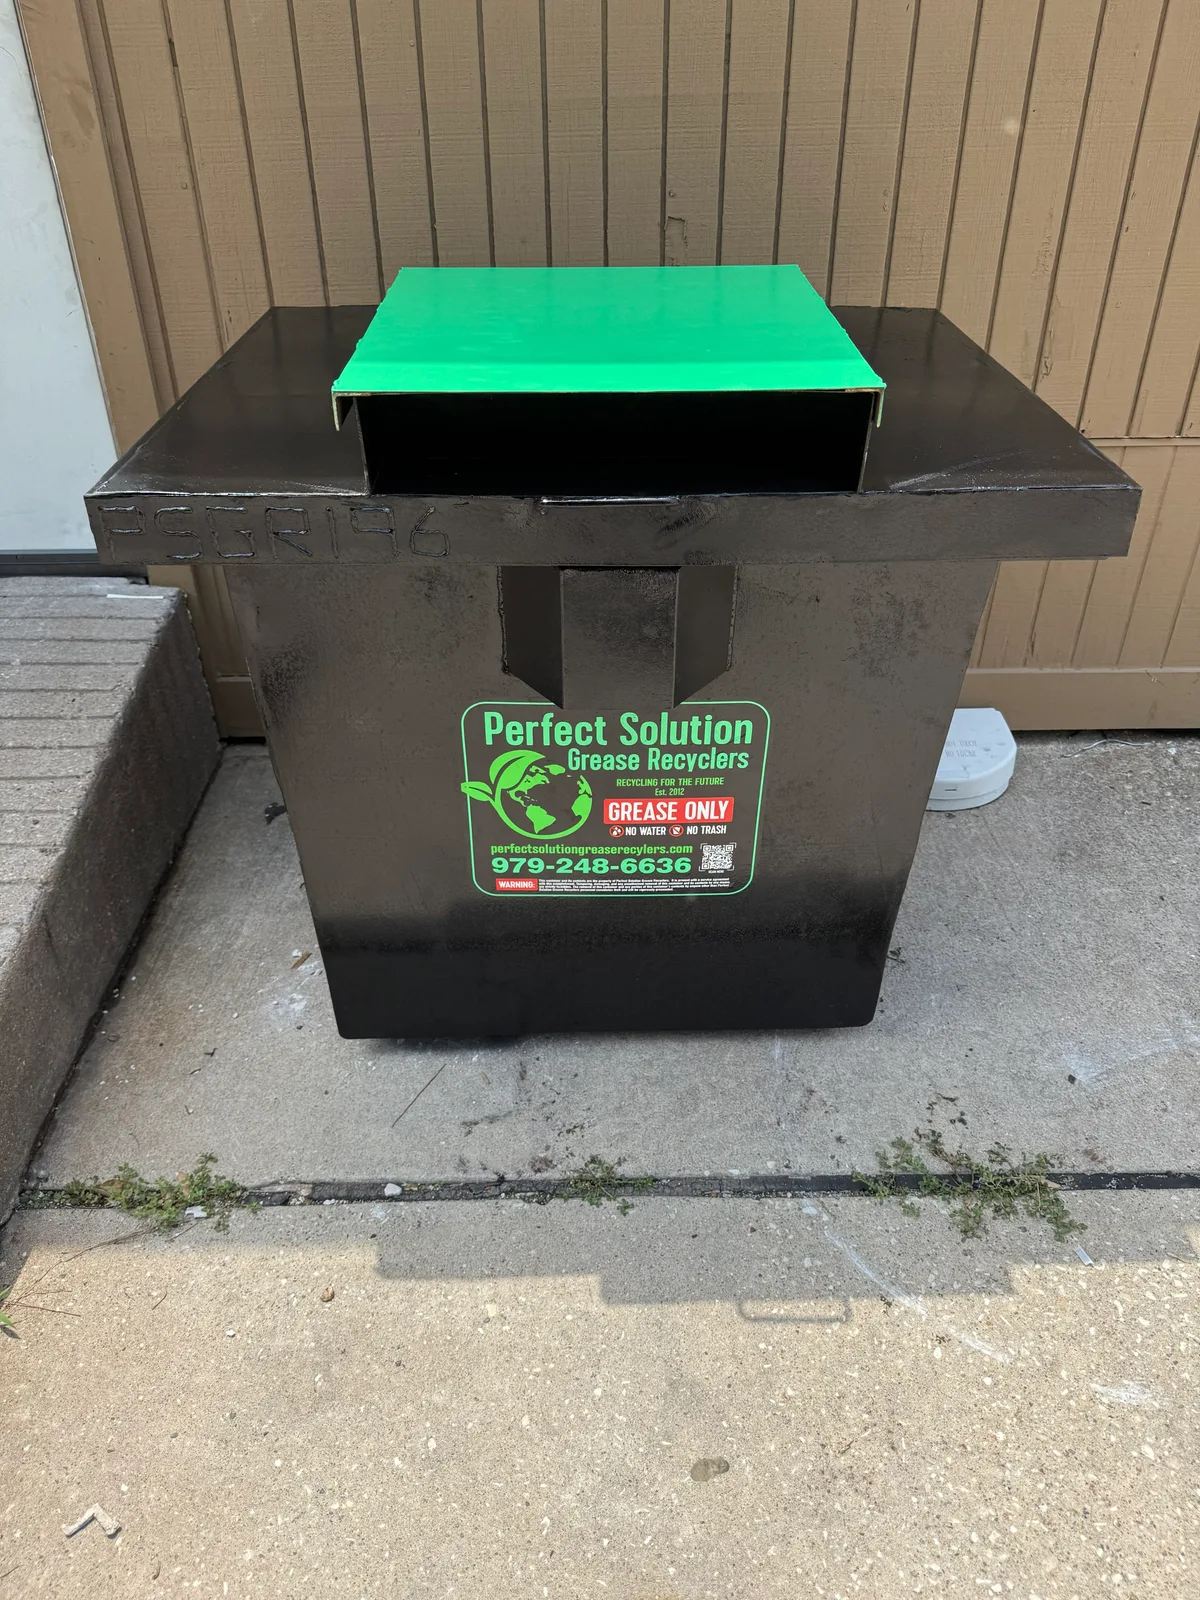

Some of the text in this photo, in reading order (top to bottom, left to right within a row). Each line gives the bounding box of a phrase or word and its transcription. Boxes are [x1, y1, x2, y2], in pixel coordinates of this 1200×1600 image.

[484, 712, 752, 746] Perfect Solution
[568, 747, 749, 772] Grease Recyclers
[616, 777, 725, 787] RECYCLING FOR THE FUTURE
[655, 788, 685, 796] Est. 2012
[609, 801, 729, 821] GREASE ONLY
[626, 827, 666, 836] NO WATER
[687, 825, 726, 835] NO TRASH
[490, 844, 693, 857] perfectsolutiongreaserecylers.com
[492, 857, 691, 874] 979-248-6636
[498, 880, 536, 889] WARNING:
